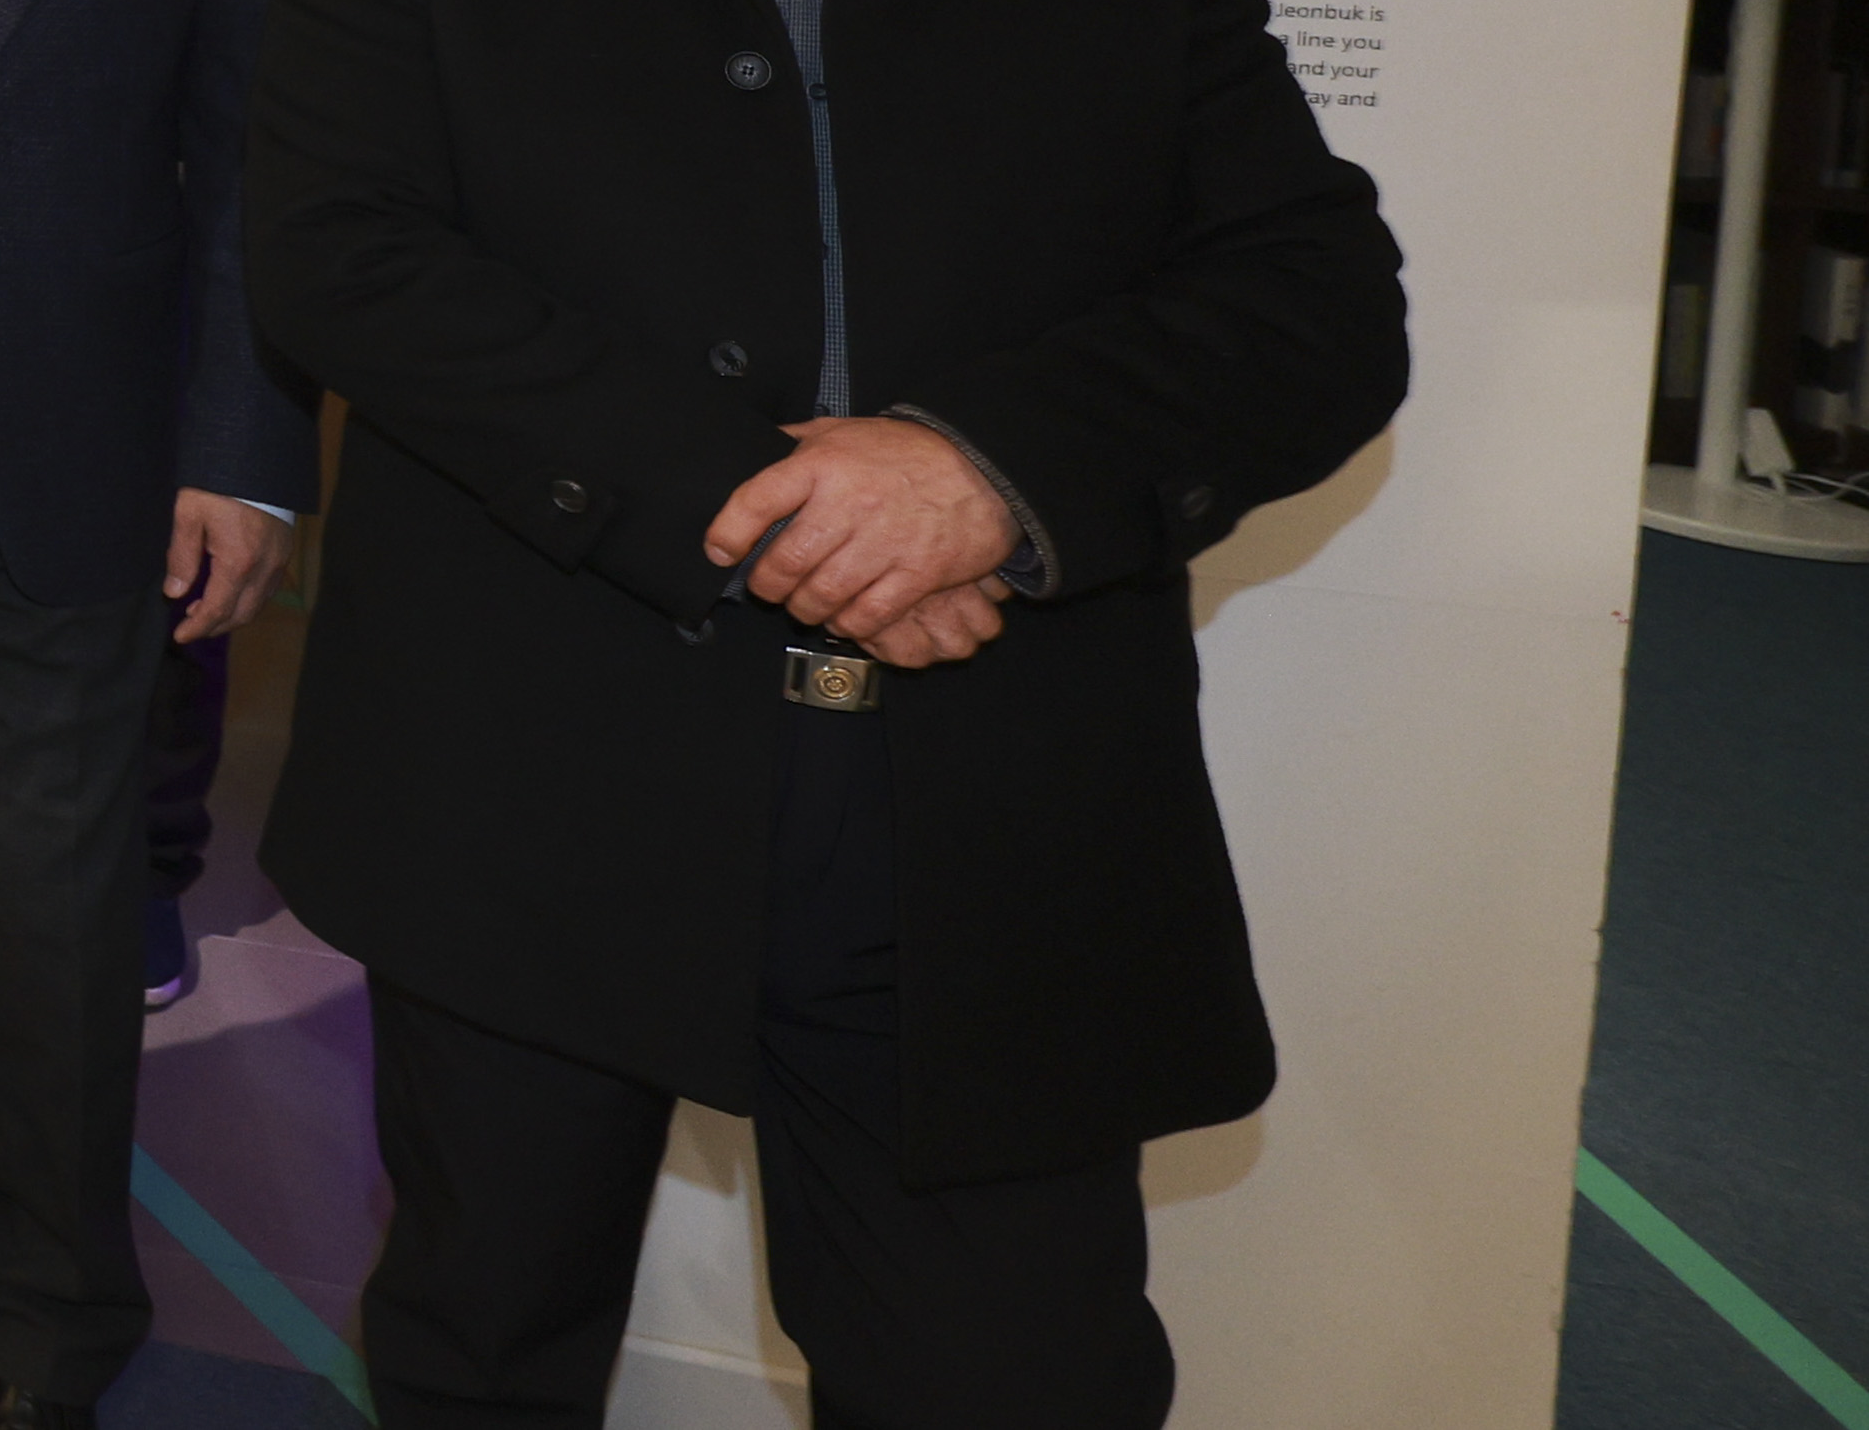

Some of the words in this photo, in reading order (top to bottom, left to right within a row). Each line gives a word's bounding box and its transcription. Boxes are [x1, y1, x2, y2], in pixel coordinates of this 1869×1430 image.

[1276, 3, 1363, 21] Jeonbuk
[1370, 6, 1385, 22] is
[1296, 31, 1336, 48] line
[1342, 36, 1382, 52] you
[1330, 66, 1380, 81] your
[1337, 91, 1376, 107] and
